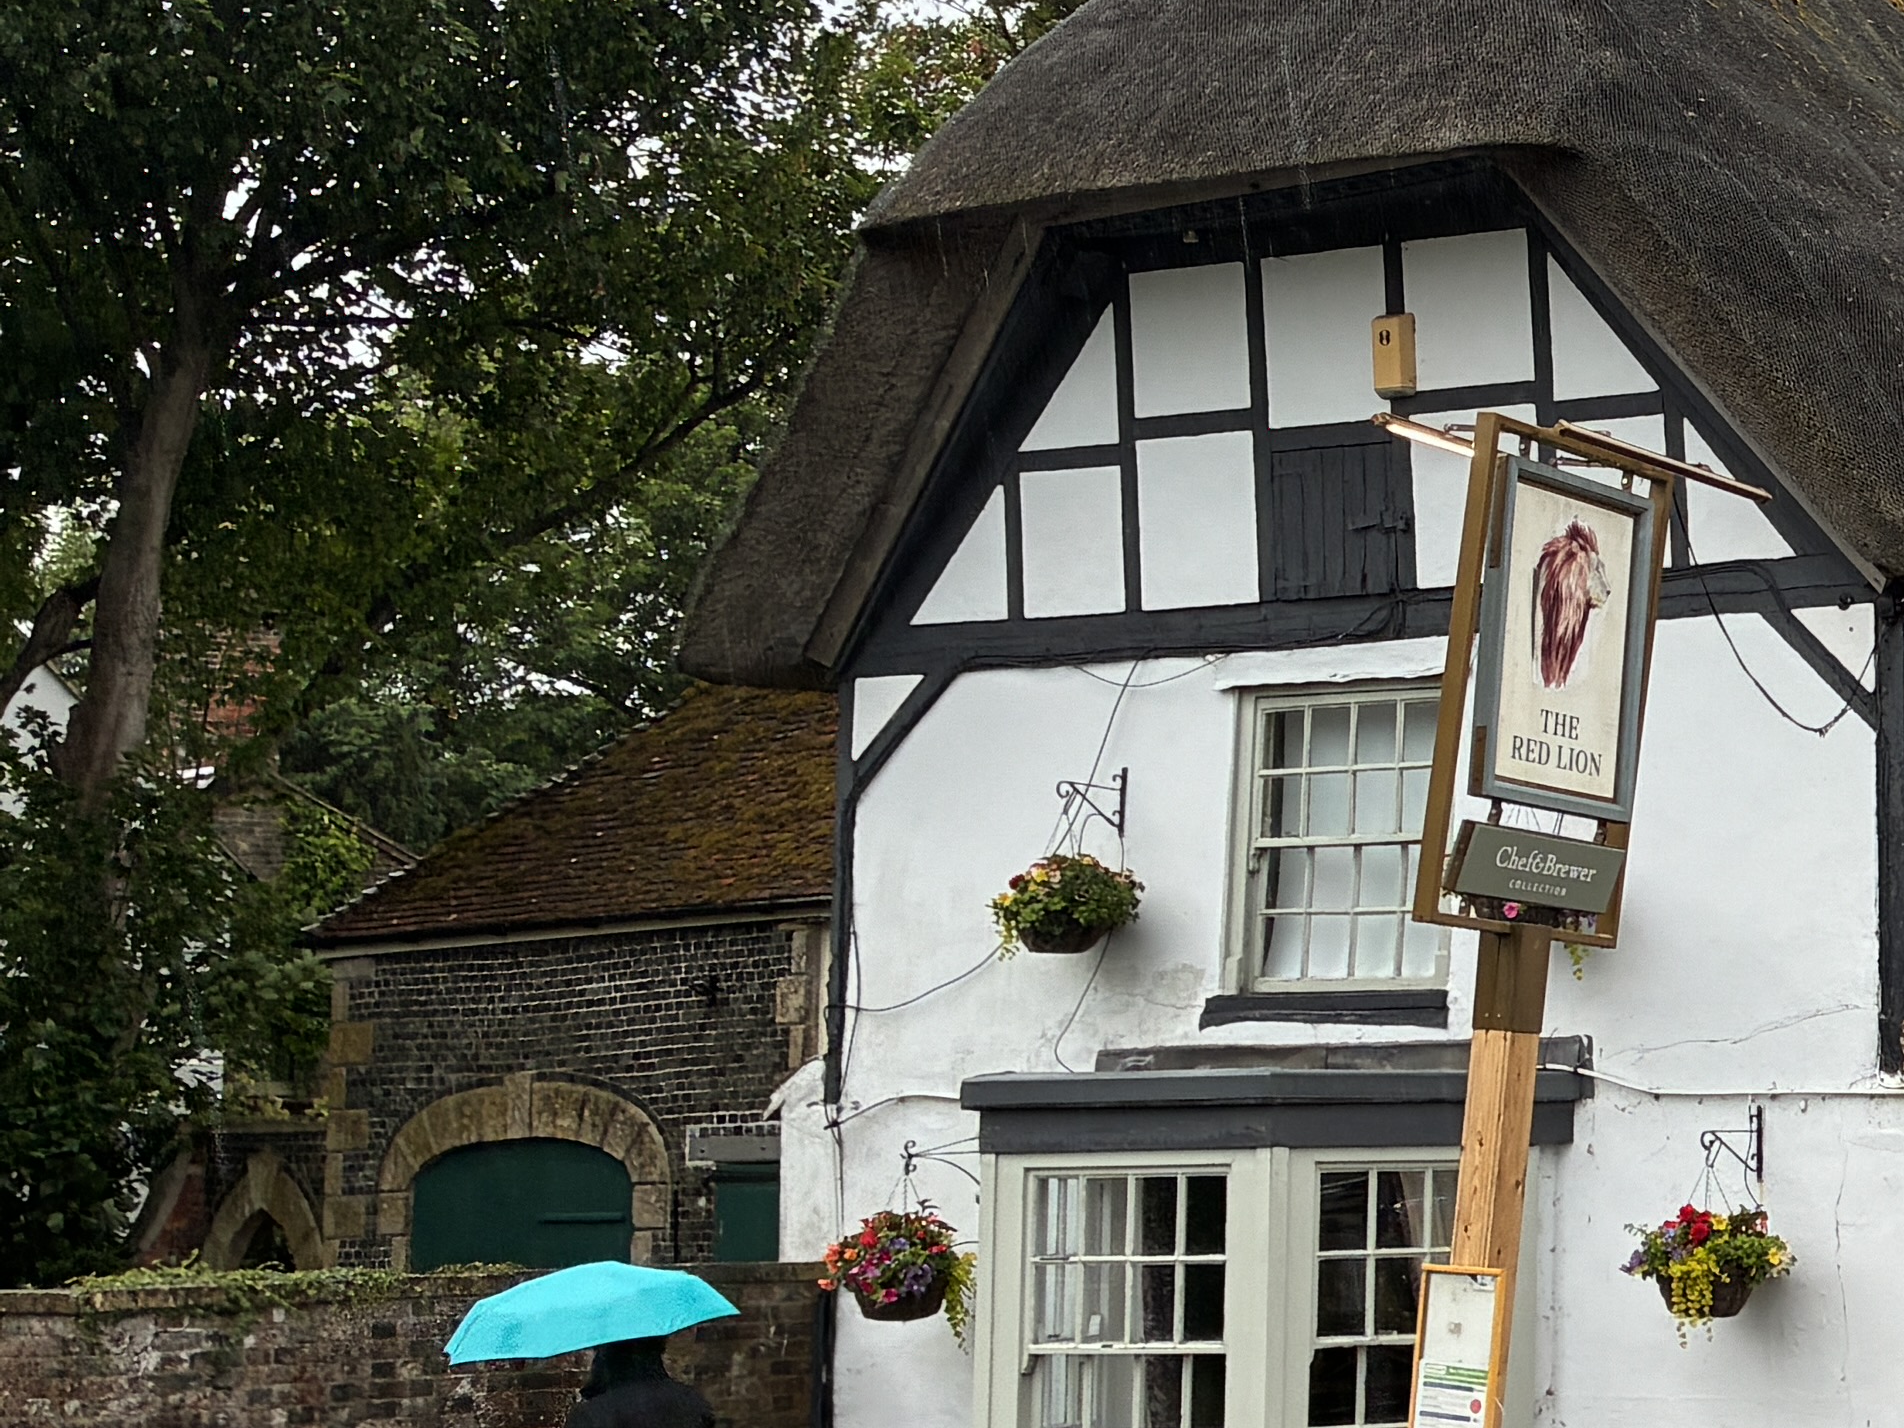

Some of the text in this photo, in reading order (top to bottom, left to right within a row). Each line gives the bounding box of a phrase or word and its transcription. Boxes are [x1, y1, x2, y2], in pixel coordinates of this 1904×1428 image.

[1540, 709, 1580, 740] THE
[1511, 735, 1602, 777] RED LION
[1495, 846, 1597, 882] Chef&Brewer
[1508, 878, 1567, 897] COLLECTION
